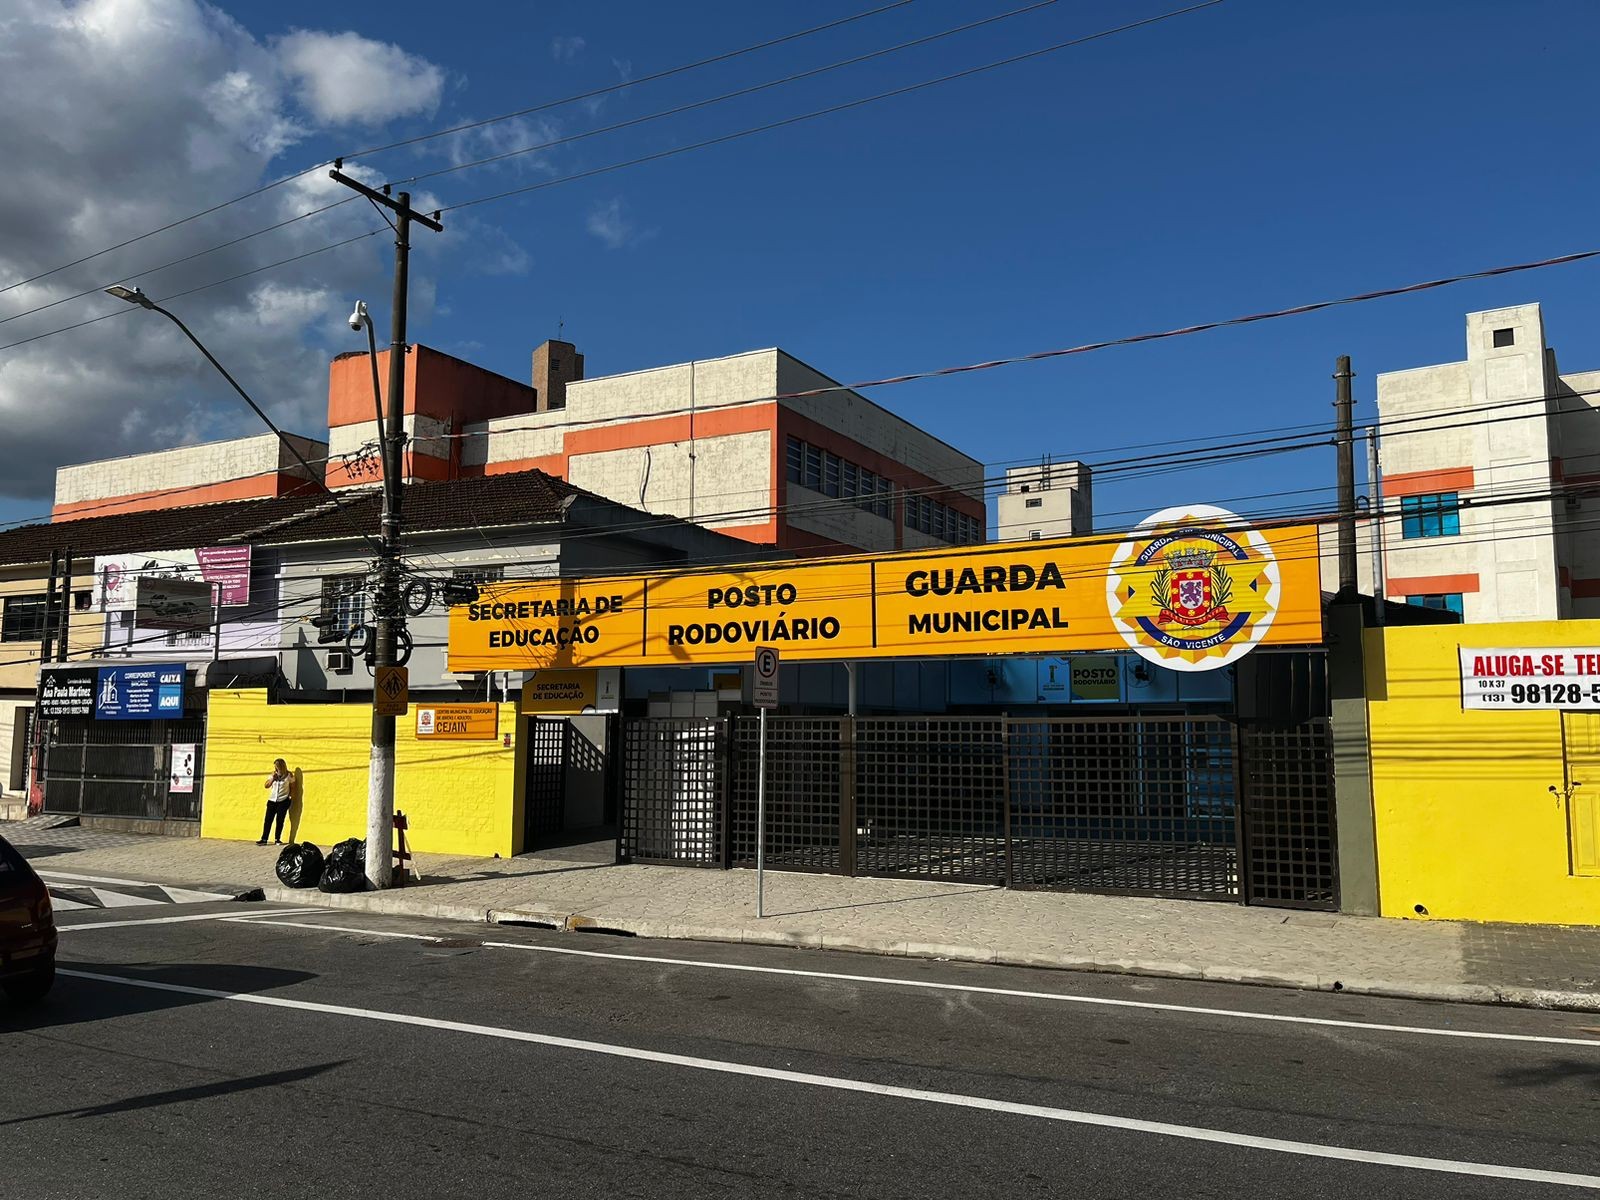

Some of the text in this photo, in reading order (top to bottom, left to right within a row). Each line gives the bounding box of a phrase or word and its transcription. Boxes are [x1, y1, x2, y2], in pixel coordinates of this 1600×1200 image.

[1198, 532, 1240, 557] UNICIPAL
[904, 561, 1066, 598] GUARDA
[707, 582, 797, 610] POSTO
[467, 595, 623, 622] SECRETARIA DE
[667, 611, 840, 646] RODOVIÁRIO
[908, 606, 1069, 635] MUNICIPAL
[489, 620, 600, 650] EDUCAÇÃO
[1160, 633, 1227, 649] SÃO VICENTE
[762, 655, 771, 673] E
[1473, 654, 1565, 677] ALUGA-SE
[160, 673, 181, 683] CAIXA
[1073, 668, 1116, 679] POSTO
[42, 685, 91, 698] Ana Paula Martinez
[536, 683, 581, 691] SECRETARIA
[1478, 680, 1505, 688] 10 X 37
[160, 696, 179, 707] AQUI
[532, 690, 584, 701] DE EDUCAÇÃO
[1482, 683, 1600, 704] (13) 98128-5
[436, 721, 467, 733] CEJAIN
